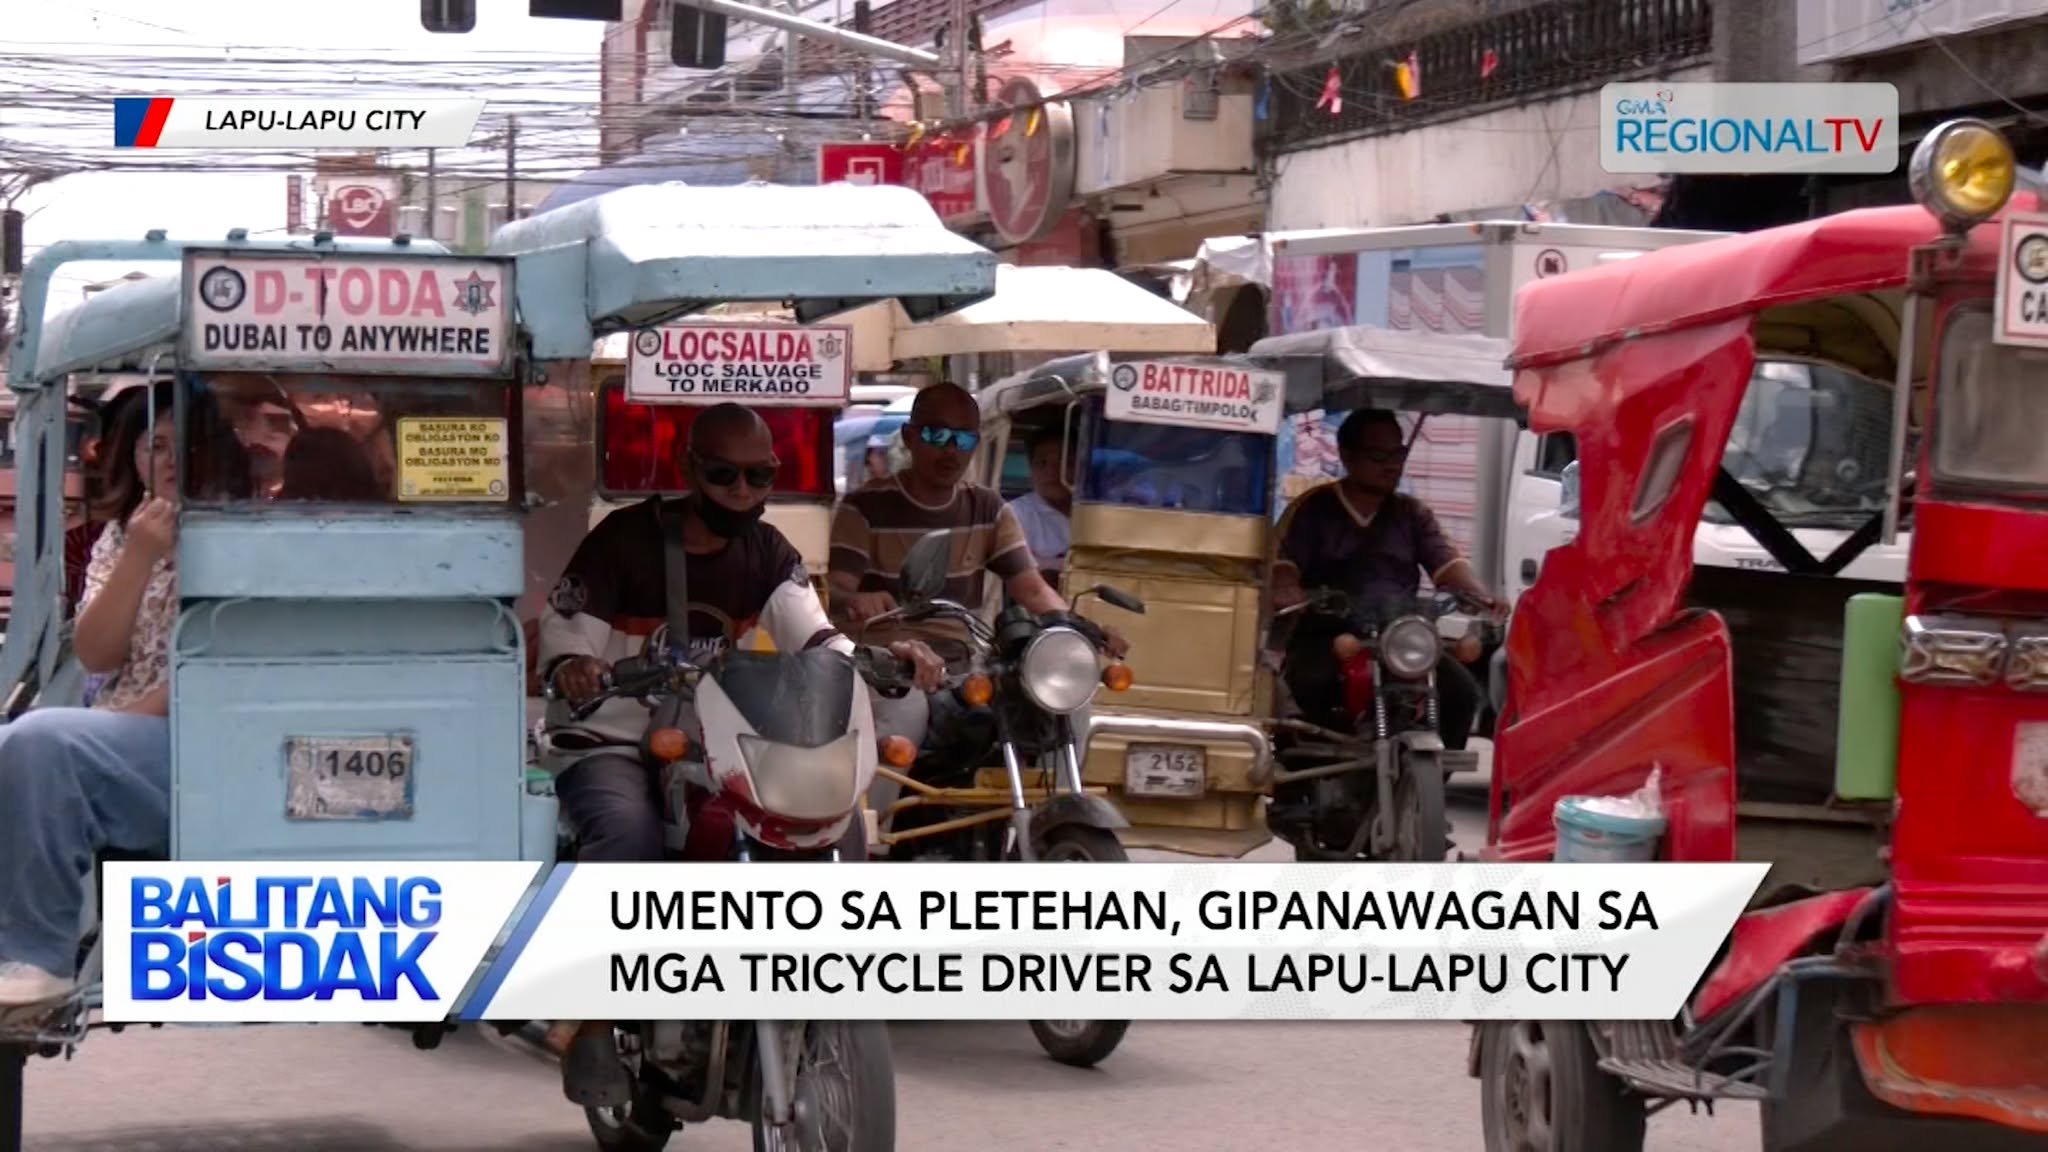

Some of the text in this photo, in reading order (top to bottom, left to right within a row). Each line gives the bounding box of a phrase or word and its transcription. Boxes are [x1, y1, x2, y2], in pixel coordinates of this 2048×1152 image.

[253, 266, 446, 318] D-TODA
[204, 324, 491, 354] DUBAI TO ANYWHERE
[662, 330, 814, 363] LOCSALDA
[655, 362, 822, 379] LOOC SALVAGE
[1143, 364, 1250, 399] BATTRIDA
[667, 379, 810, 394] TO MERKADO
[484, 433, 500, 442] KO
[418, 447, 488, 457] BASURA MO
[325, 750, 406, 778] 1406
[1151, 753, 1198, 772] 2152
